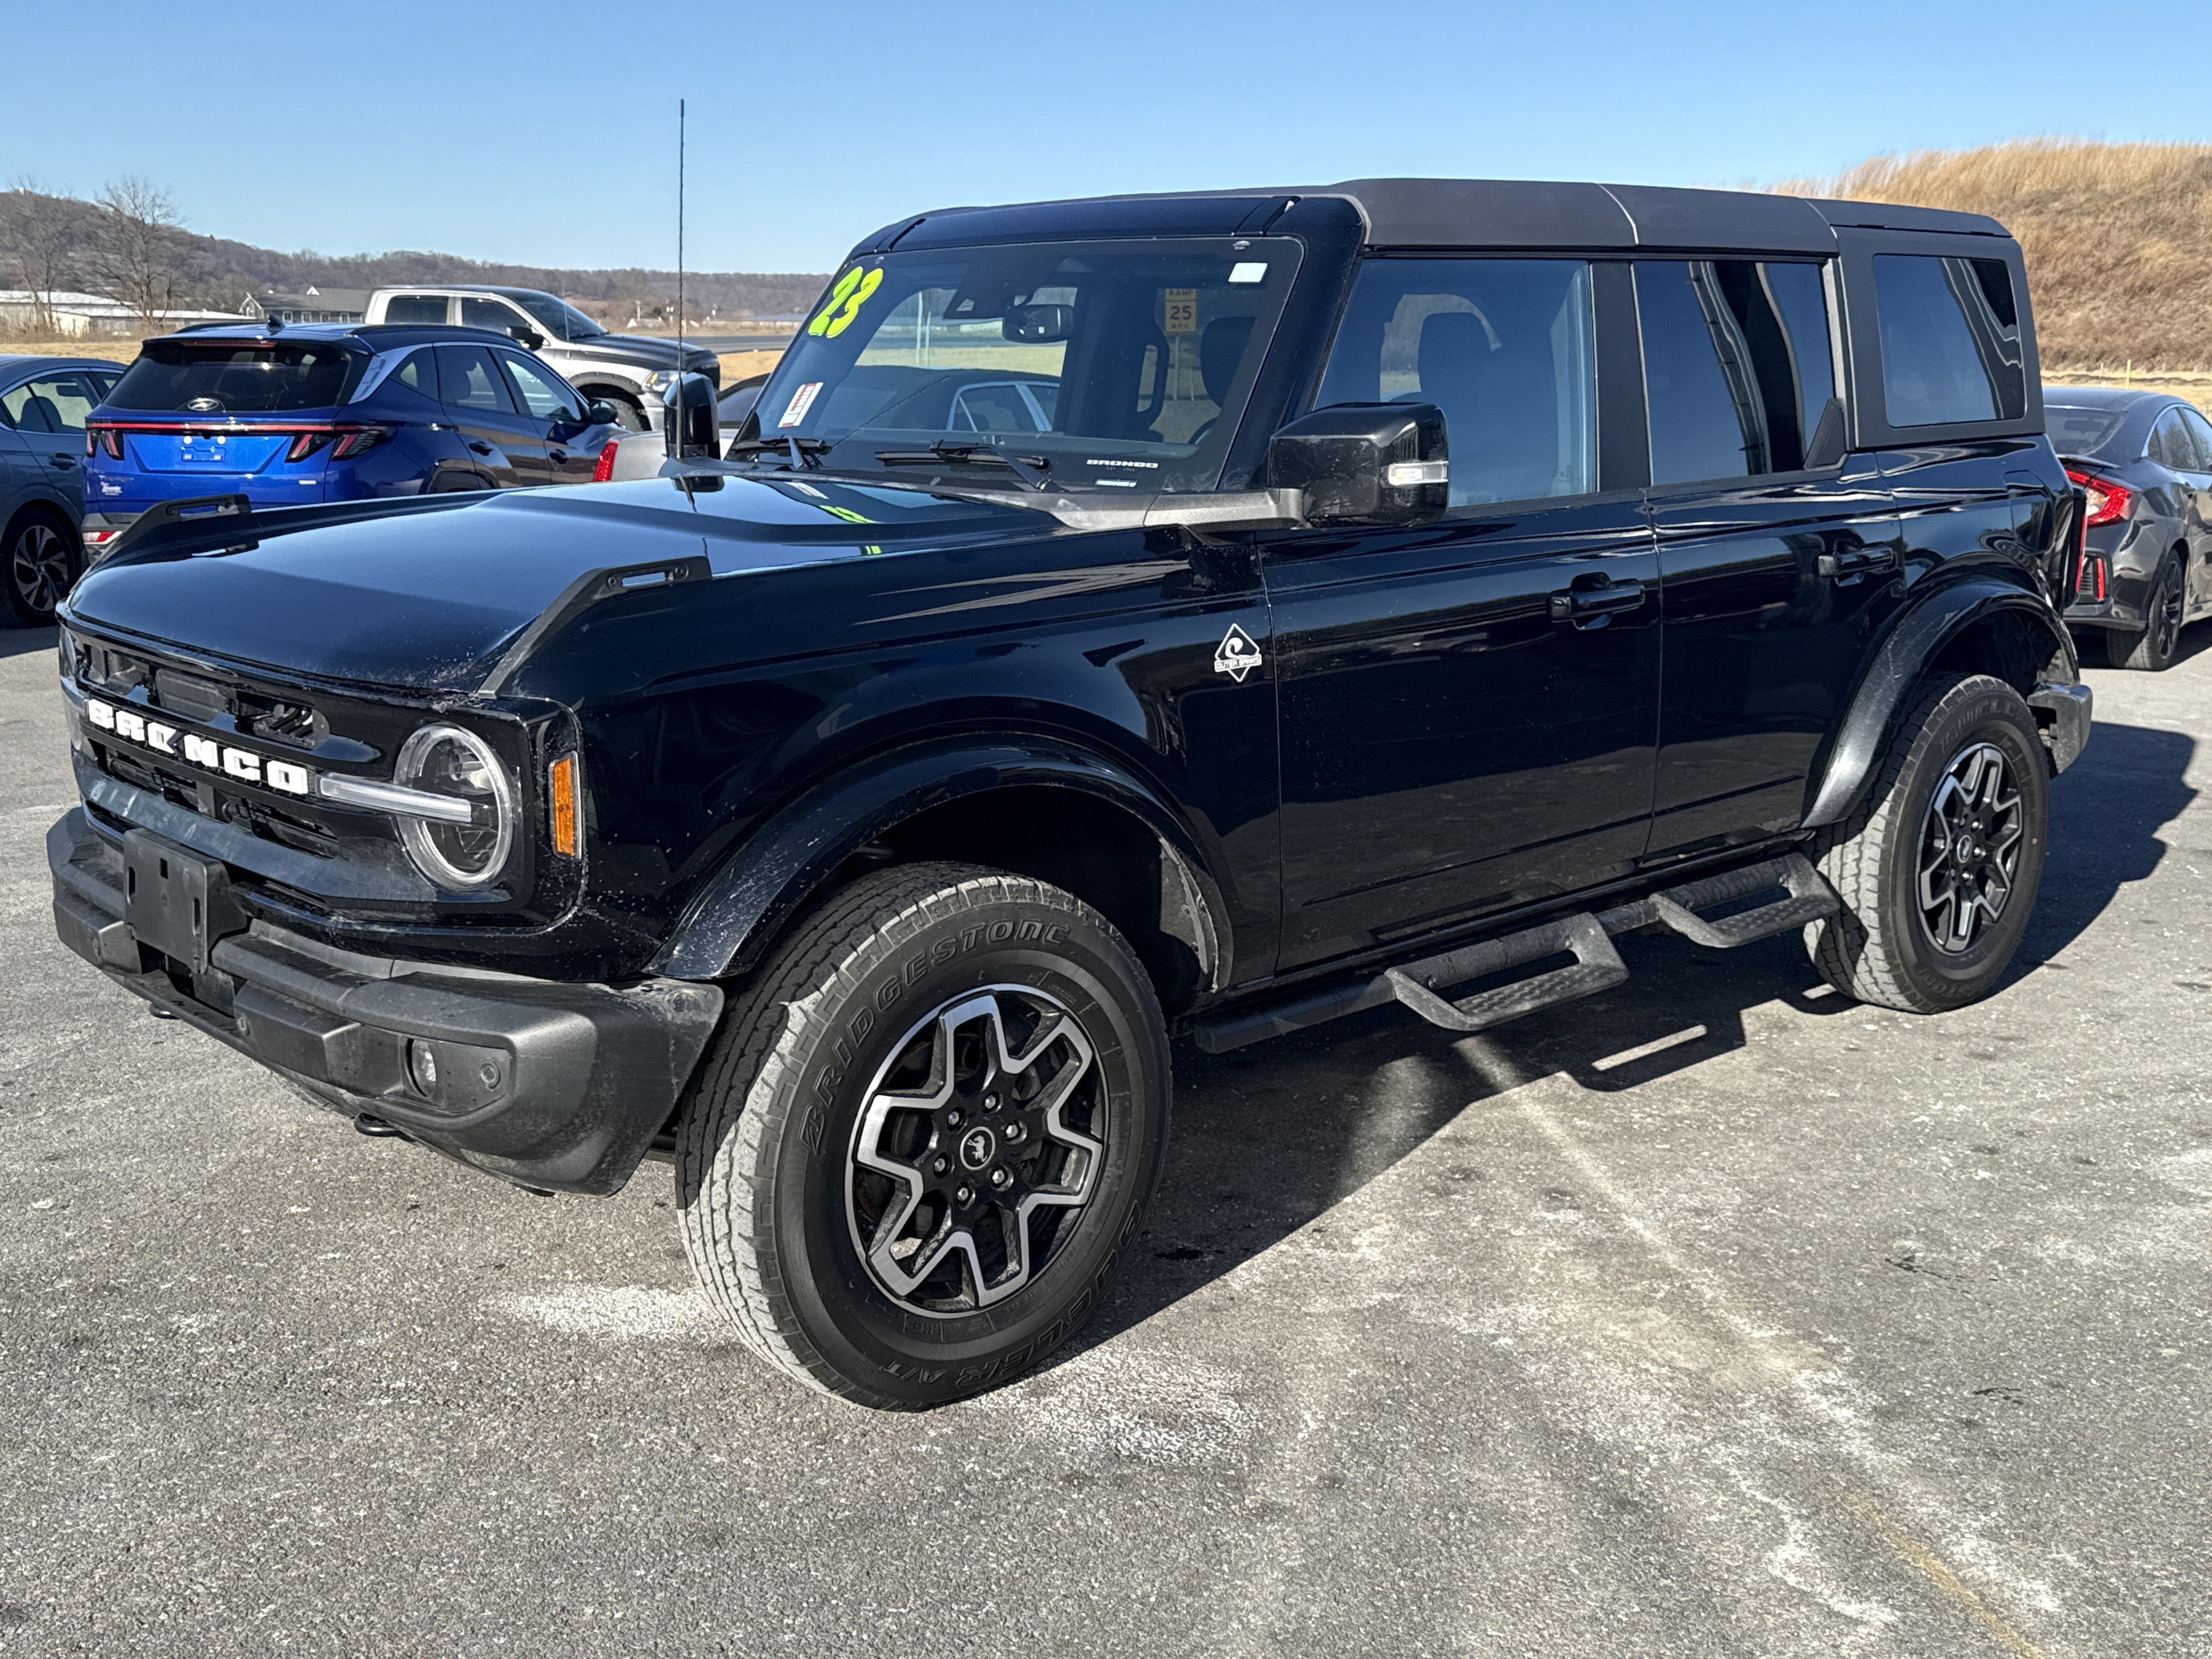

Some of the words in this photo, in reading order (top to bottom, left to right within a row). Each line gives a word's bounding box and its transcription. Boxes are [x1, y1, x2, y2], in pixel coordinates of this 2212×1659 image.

[808, 266, 883, 338] 23
[1170, 306, 1192, 320] 25
[1086, 459, 1159, 469] BRONCO
[88, 699, 308, 795] BRONCO
[797, 918, 1071, 1155] BRIDGESTONE
[956, 1200, 1142, 1389] DUELER
